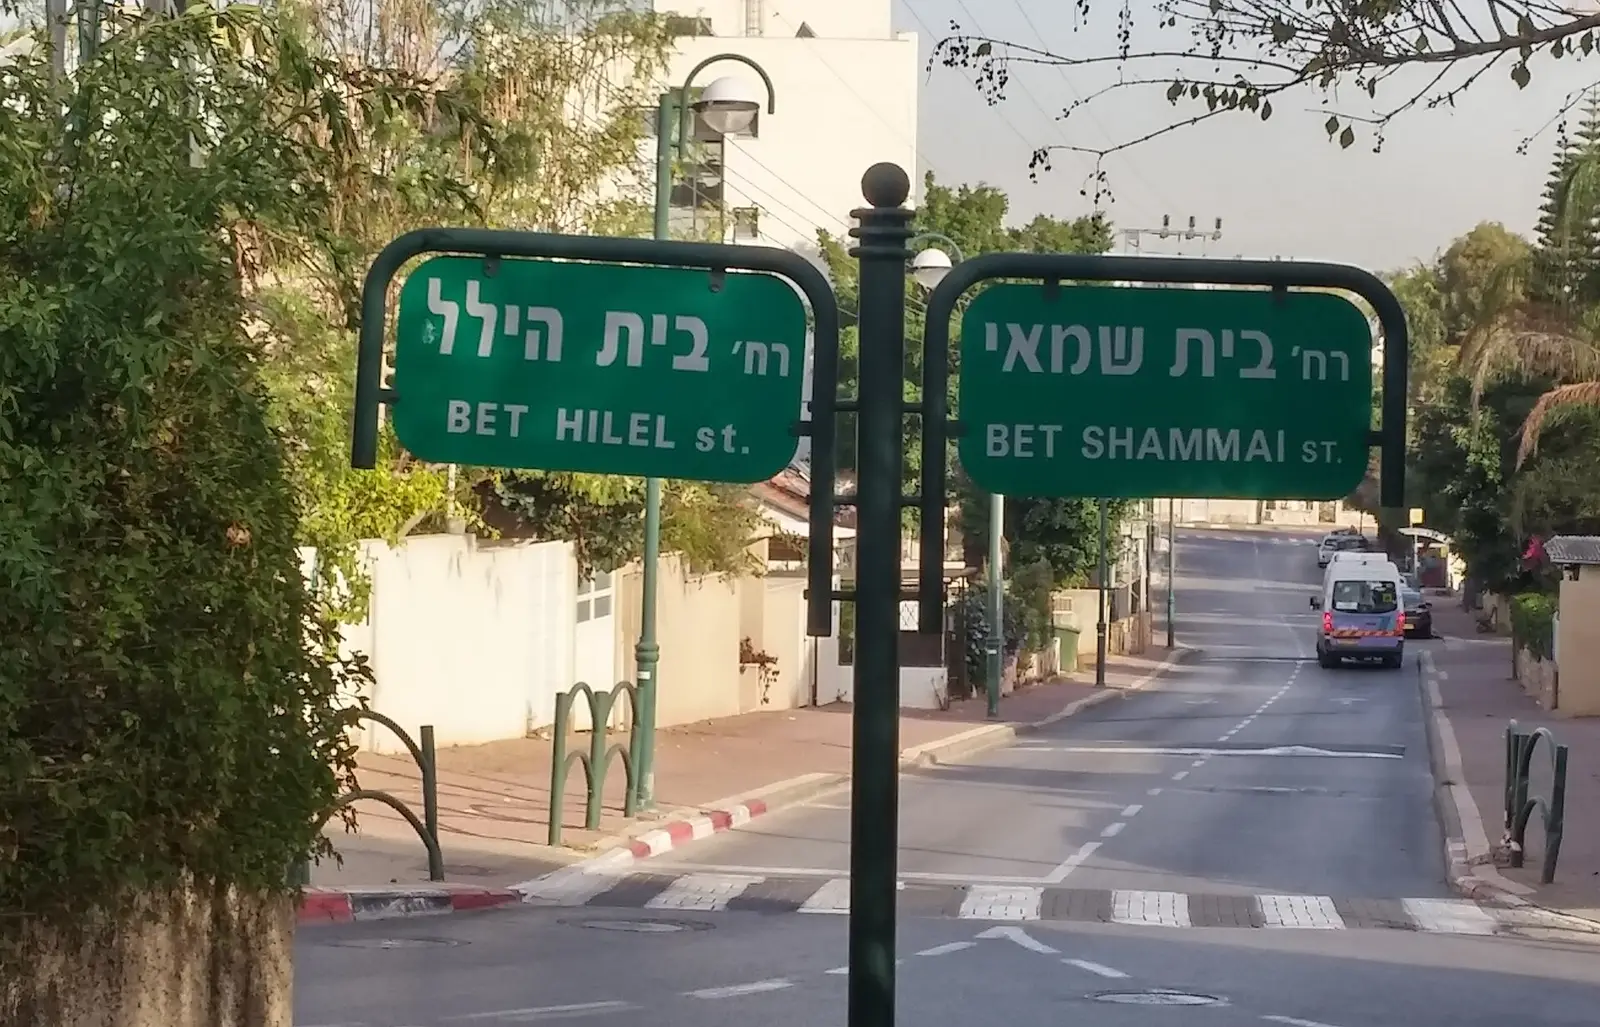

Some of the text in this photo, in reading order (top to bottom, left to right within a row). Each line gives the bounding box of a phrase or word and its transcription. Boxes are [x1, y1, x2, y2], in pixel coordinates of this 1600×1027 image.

[427, 277, 564, 362] הילל
[596, 310, 710, 372] בית
[985, 321, 1144, 377] שמאי
[1169, 327, 1277, 379] בית
[447, 400, 750, 454] BET HILEL st.
[986, 423, 1342, 464] BET SHAMMAI ST.
